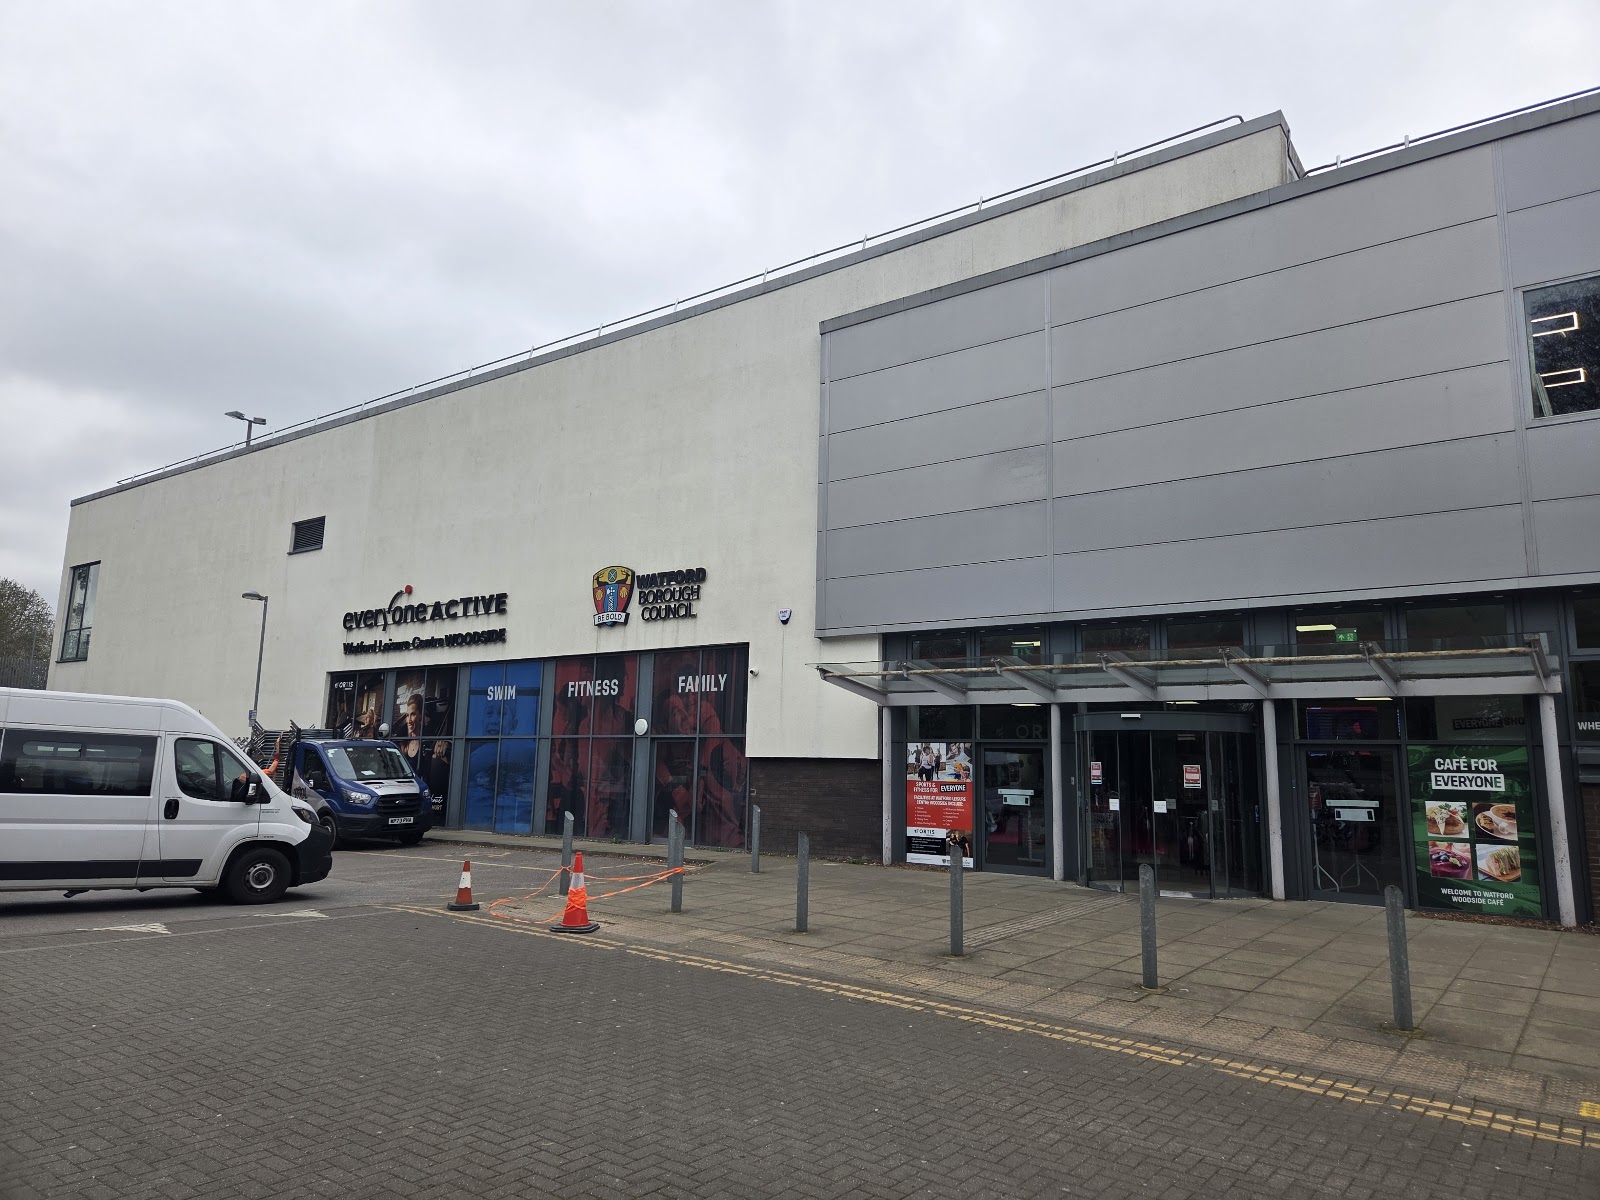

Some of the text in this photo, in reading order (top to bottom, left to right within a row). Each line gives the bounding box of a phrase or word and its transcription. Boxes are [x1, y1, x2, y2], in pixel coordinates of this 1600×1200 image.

[636, 567, 706, 589] WATFORD
[638, 584, 700, 605] BOROUGH
[343, 590, 508, 631] everyone ACTIVE
[597, 613, 623, 623] BE BOLD
[641, 602, 697, 621] COUNCIL
[444, 628, 507, 648] WOODSIDE
[567, 679, 619, 697] FITNESS
[678, 673, 728, 693] FAMILY
[486, 685, 516, 701] SWIM
[1434, 756, 1498, 771] CAFÉ FOR
[940, 784, 966, 792] EVERYONE
[1434, 775, 1502, 788] EVERYONE
[1440, 887, 1473, 897] WELCOME
[1482, 891, 1514, 900] WATFORD
[1451, 895, 1487, 905] WOODSIDE
